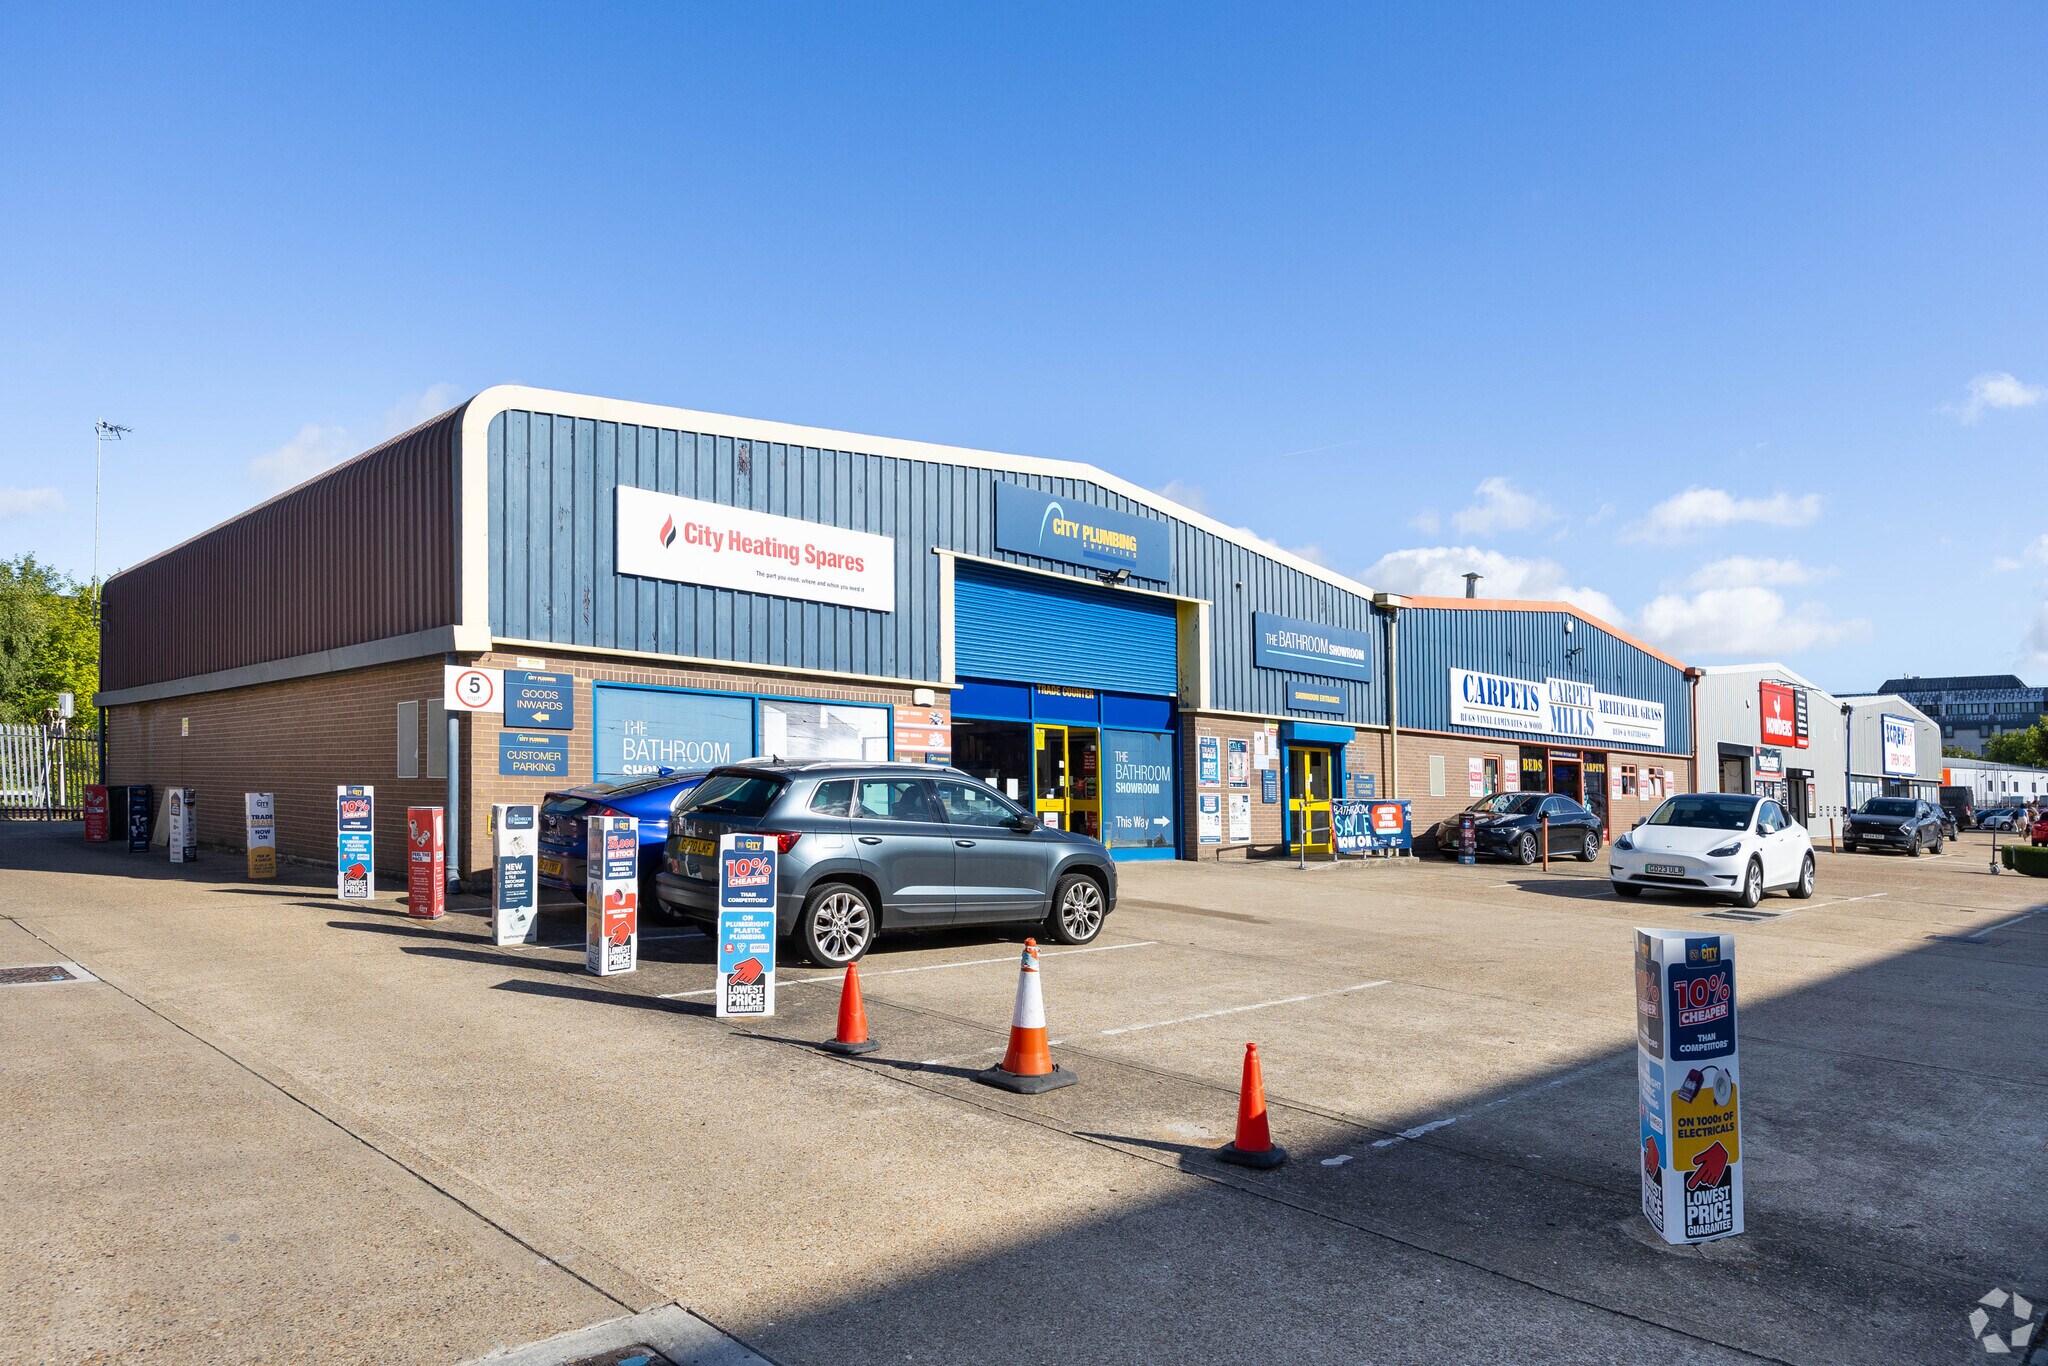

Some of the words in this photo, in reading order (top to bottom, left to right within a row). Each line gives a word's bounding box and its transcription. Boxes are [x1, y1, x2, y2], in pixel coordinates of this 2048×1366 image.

[1053, 518, 1080, 539] CITY
[1082, 524, 1136, 551] PLUMBING
[684, 522, 724, 552] City
[728, 530, 800, 566] Heating
[804, 543, 864, 572] Spares
[1084, 542, 1136, 558] SUPPLIES
[1265, 632, 1278, 646] THE
[1279, 630, 1328, 654] BATHROOM
[1329, 644, 1364, 660] SHOWROOM
[469, 677, 480, 693] 5
[1037, 684, 1060, 696] TRADE
[1062, 686, 1094, 699] COUNTER
[1463, 673, 1539, 712] CARPETS
[522, 689, 558, 700] GOODS
[1549, 680, 1593, 706] CARPET
[517, 700, 562, 710] INWARDS
[1598, 699, 1639, 718] ARTIFICIAL
[1641, 706, 1662, 721] GRASS
[623, 720, 648, 736] THE
[1460, 713, 1475, 722] RUGS
[1477, 715, 1493, 724] VINYL
[1494, 717, 1522, 728] LAMINATES
[1550, 705, 1594, 736] MILLS
[1766, 717, 1792, 737] HOWDENS
[507, 751, 561, 761] CUSTOMER
[623, 738, 730, 764] BATHROOM
[1115, 751, 1128, 762] THE
[513, 762, 556, 771] PARKING
[1522, 758, 1542, 772] BEDS
[1584, 762, 1605, 773] CARPETS
[1115, 764, 1170, 782] BATHROOM
[1115, 783, 1159, 794] SHOWROOM
[341, 800, 370, 812] 10%
[1333, 804, 1368, 815] BATHROOM
[1116, 816, 1132, 828] This
[1133, 817, 1149, 830] Way
[1335, 815, 1370, 836] SALE
[608, 838, 635, 850] 20,000
[1337, 836, 1355, 848] NOW
[1357, 835, 1372, 847] ON
[616, 849, 634, 858] STOCK
[726, 857, 772, 877] 10%
[1650, 864, 1667, 872] GD23
[730, 877, 767, 886] CHEAPER
[609, 945, 630, 954] LOWEST
[1702, 948, 1718, 960] CITY
[609, 953, 630, 965] PRICE
[728, 985, 764, 994] LOWEST
[1674, 972, 1730, 1010] 10%
[728, 994, 763, 1005] PRICE
[1682, 1005, 1726, 1023] CHEAPER
[1697, 1033, 1716, 1042] THAN
[1678, 1118, 1694, 1127] ON
[1696, 1114, 1722, 1126] 1000s
[1723, 1111, 1733, 1121] OF
[1678, 1123, 1734, 1139] ELECTRICALS
[1687, 1185, 1730, 1206] LOWEST
[1688, 1200, 1731, 1225] PRICE
[1688, 1220, 1731, 1236] GUARANTEE
